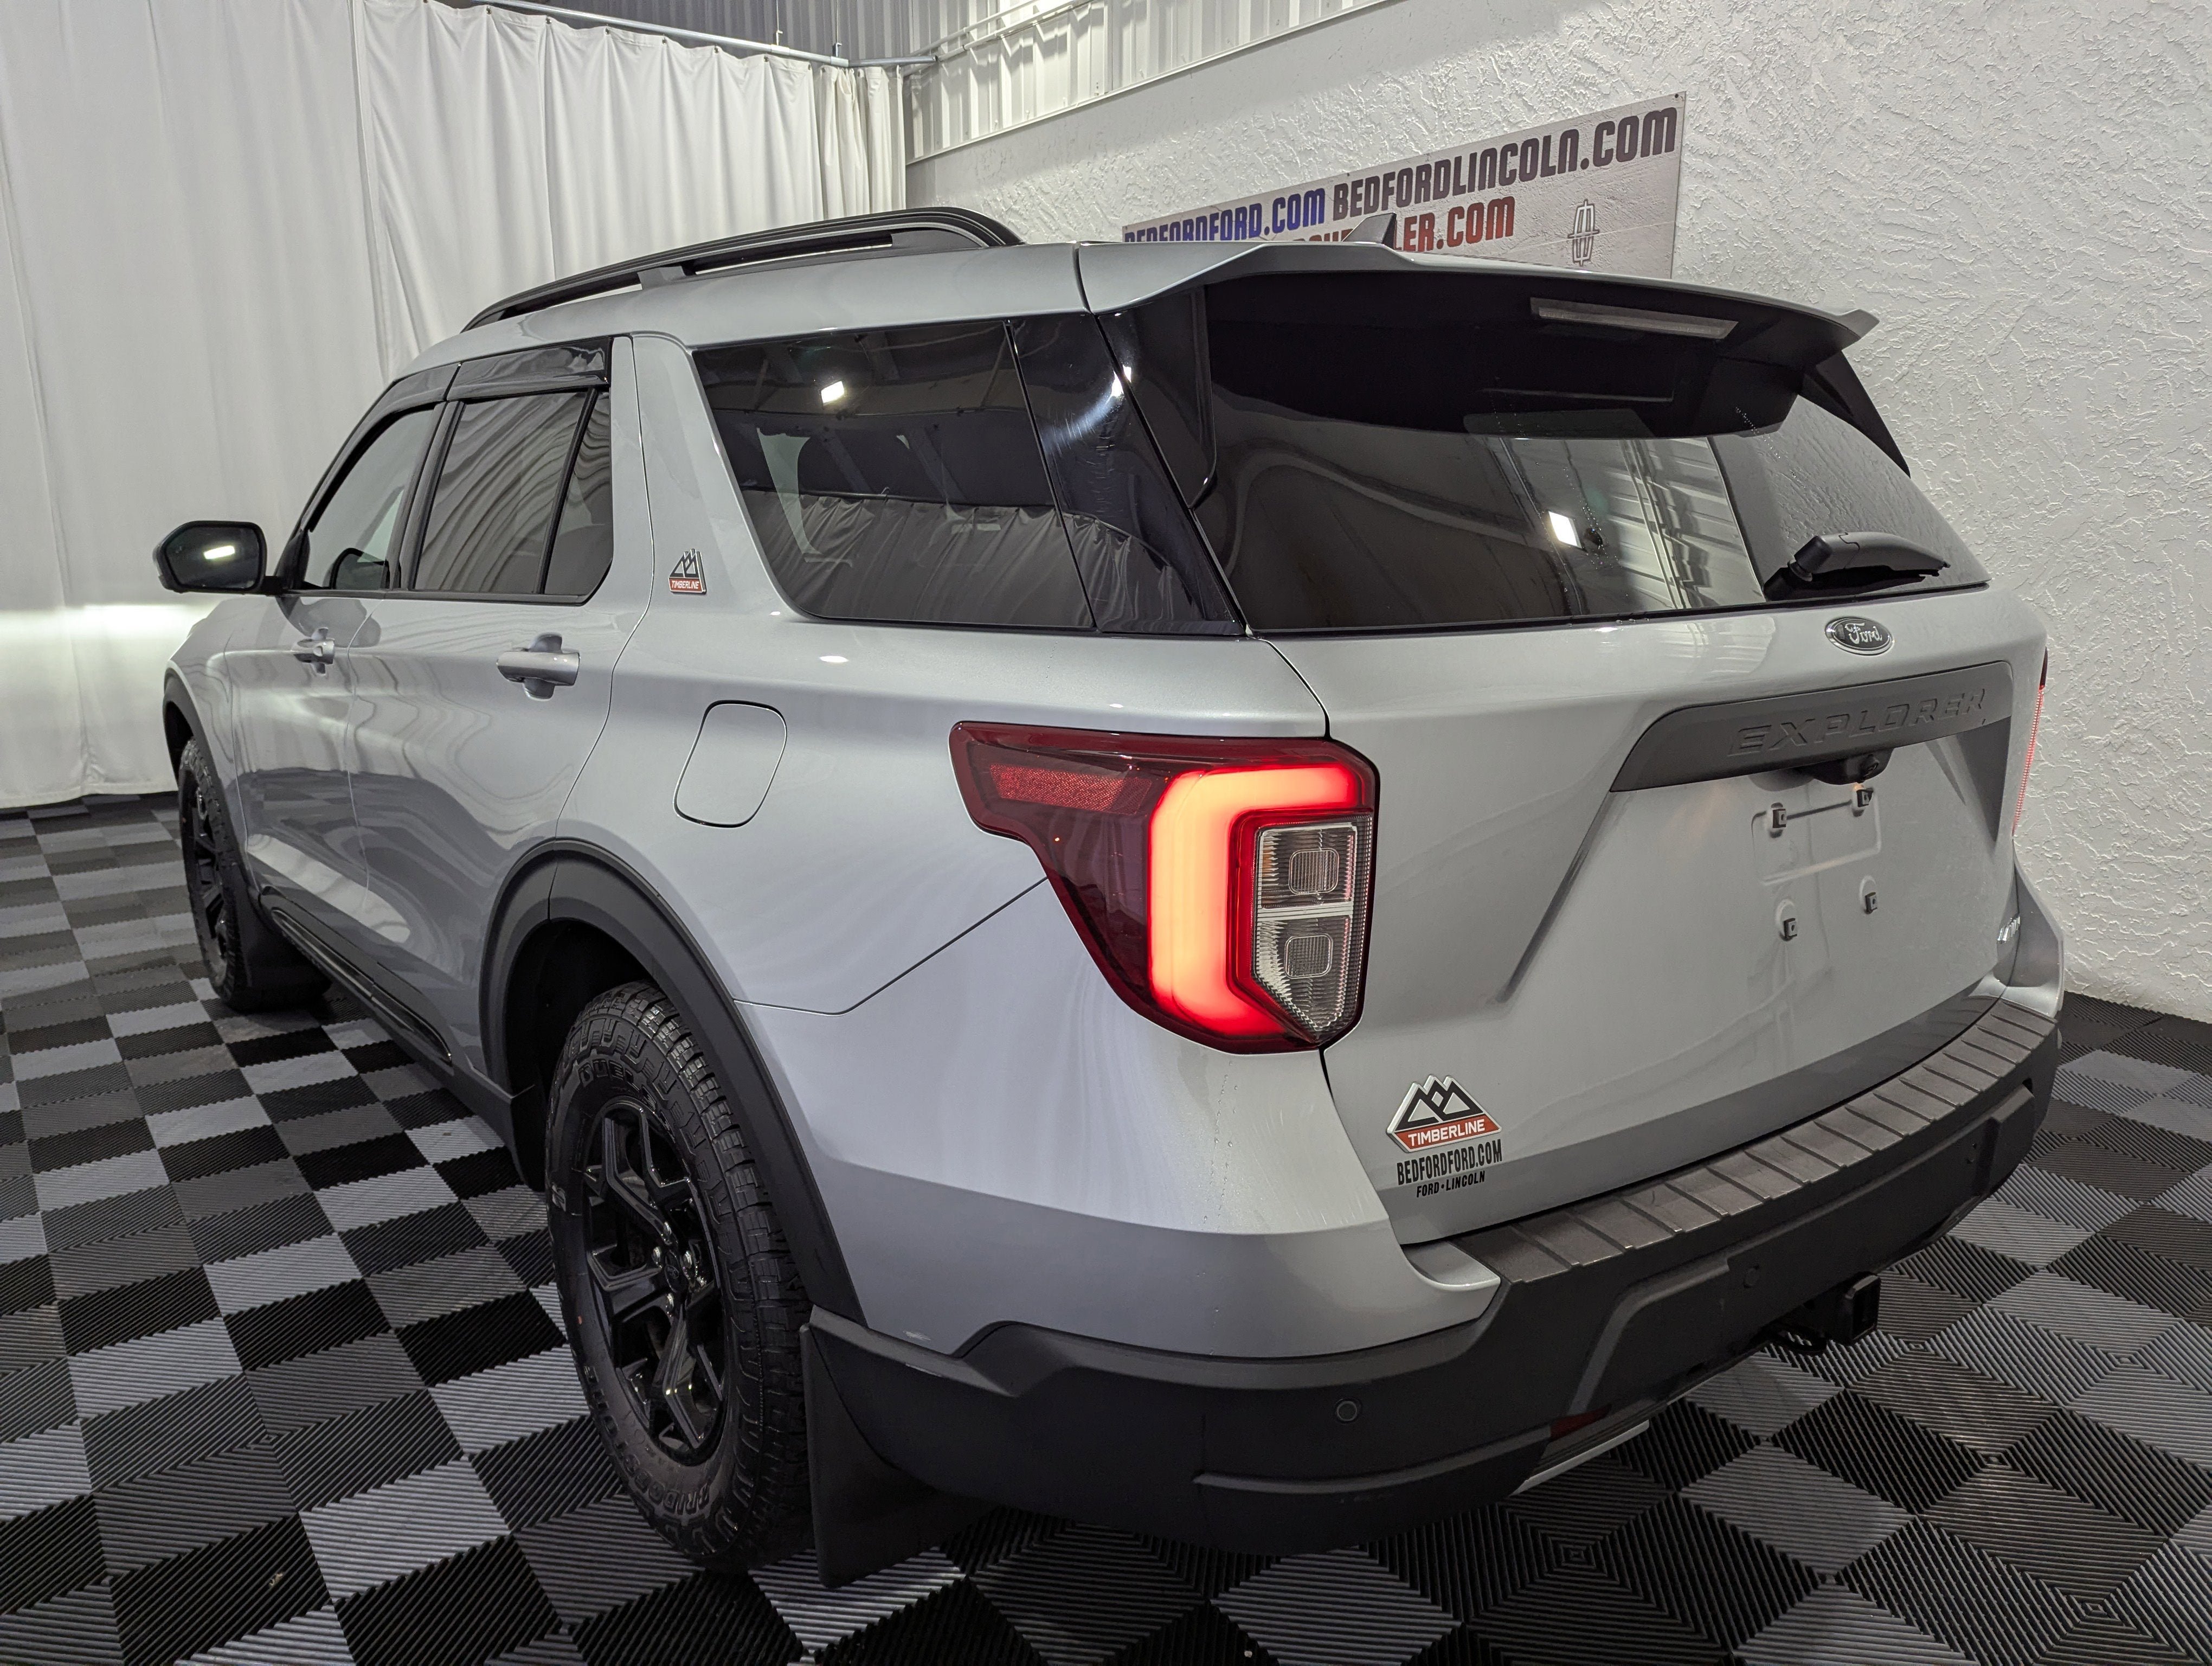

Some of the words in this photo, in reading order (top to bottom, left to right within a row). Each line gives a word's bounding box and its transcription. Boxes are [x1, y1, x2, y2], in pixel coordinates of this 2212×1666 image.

[1125, 188, 1325, 242] FORDFORD.COM
[1334, 107, 1677, 221] BEDFORDLINCOLN.COM
[671, 580, 700, 589] TIMBERLINE
[1844, 622, 1882, 644] Ford
[1728, 688, 1985, 757] EXPLORER
[1407, 1119, 1486, 1146] TIMBERLINE
[1397, 1139, 1503, 1186] BEDFORDFORD.COM
